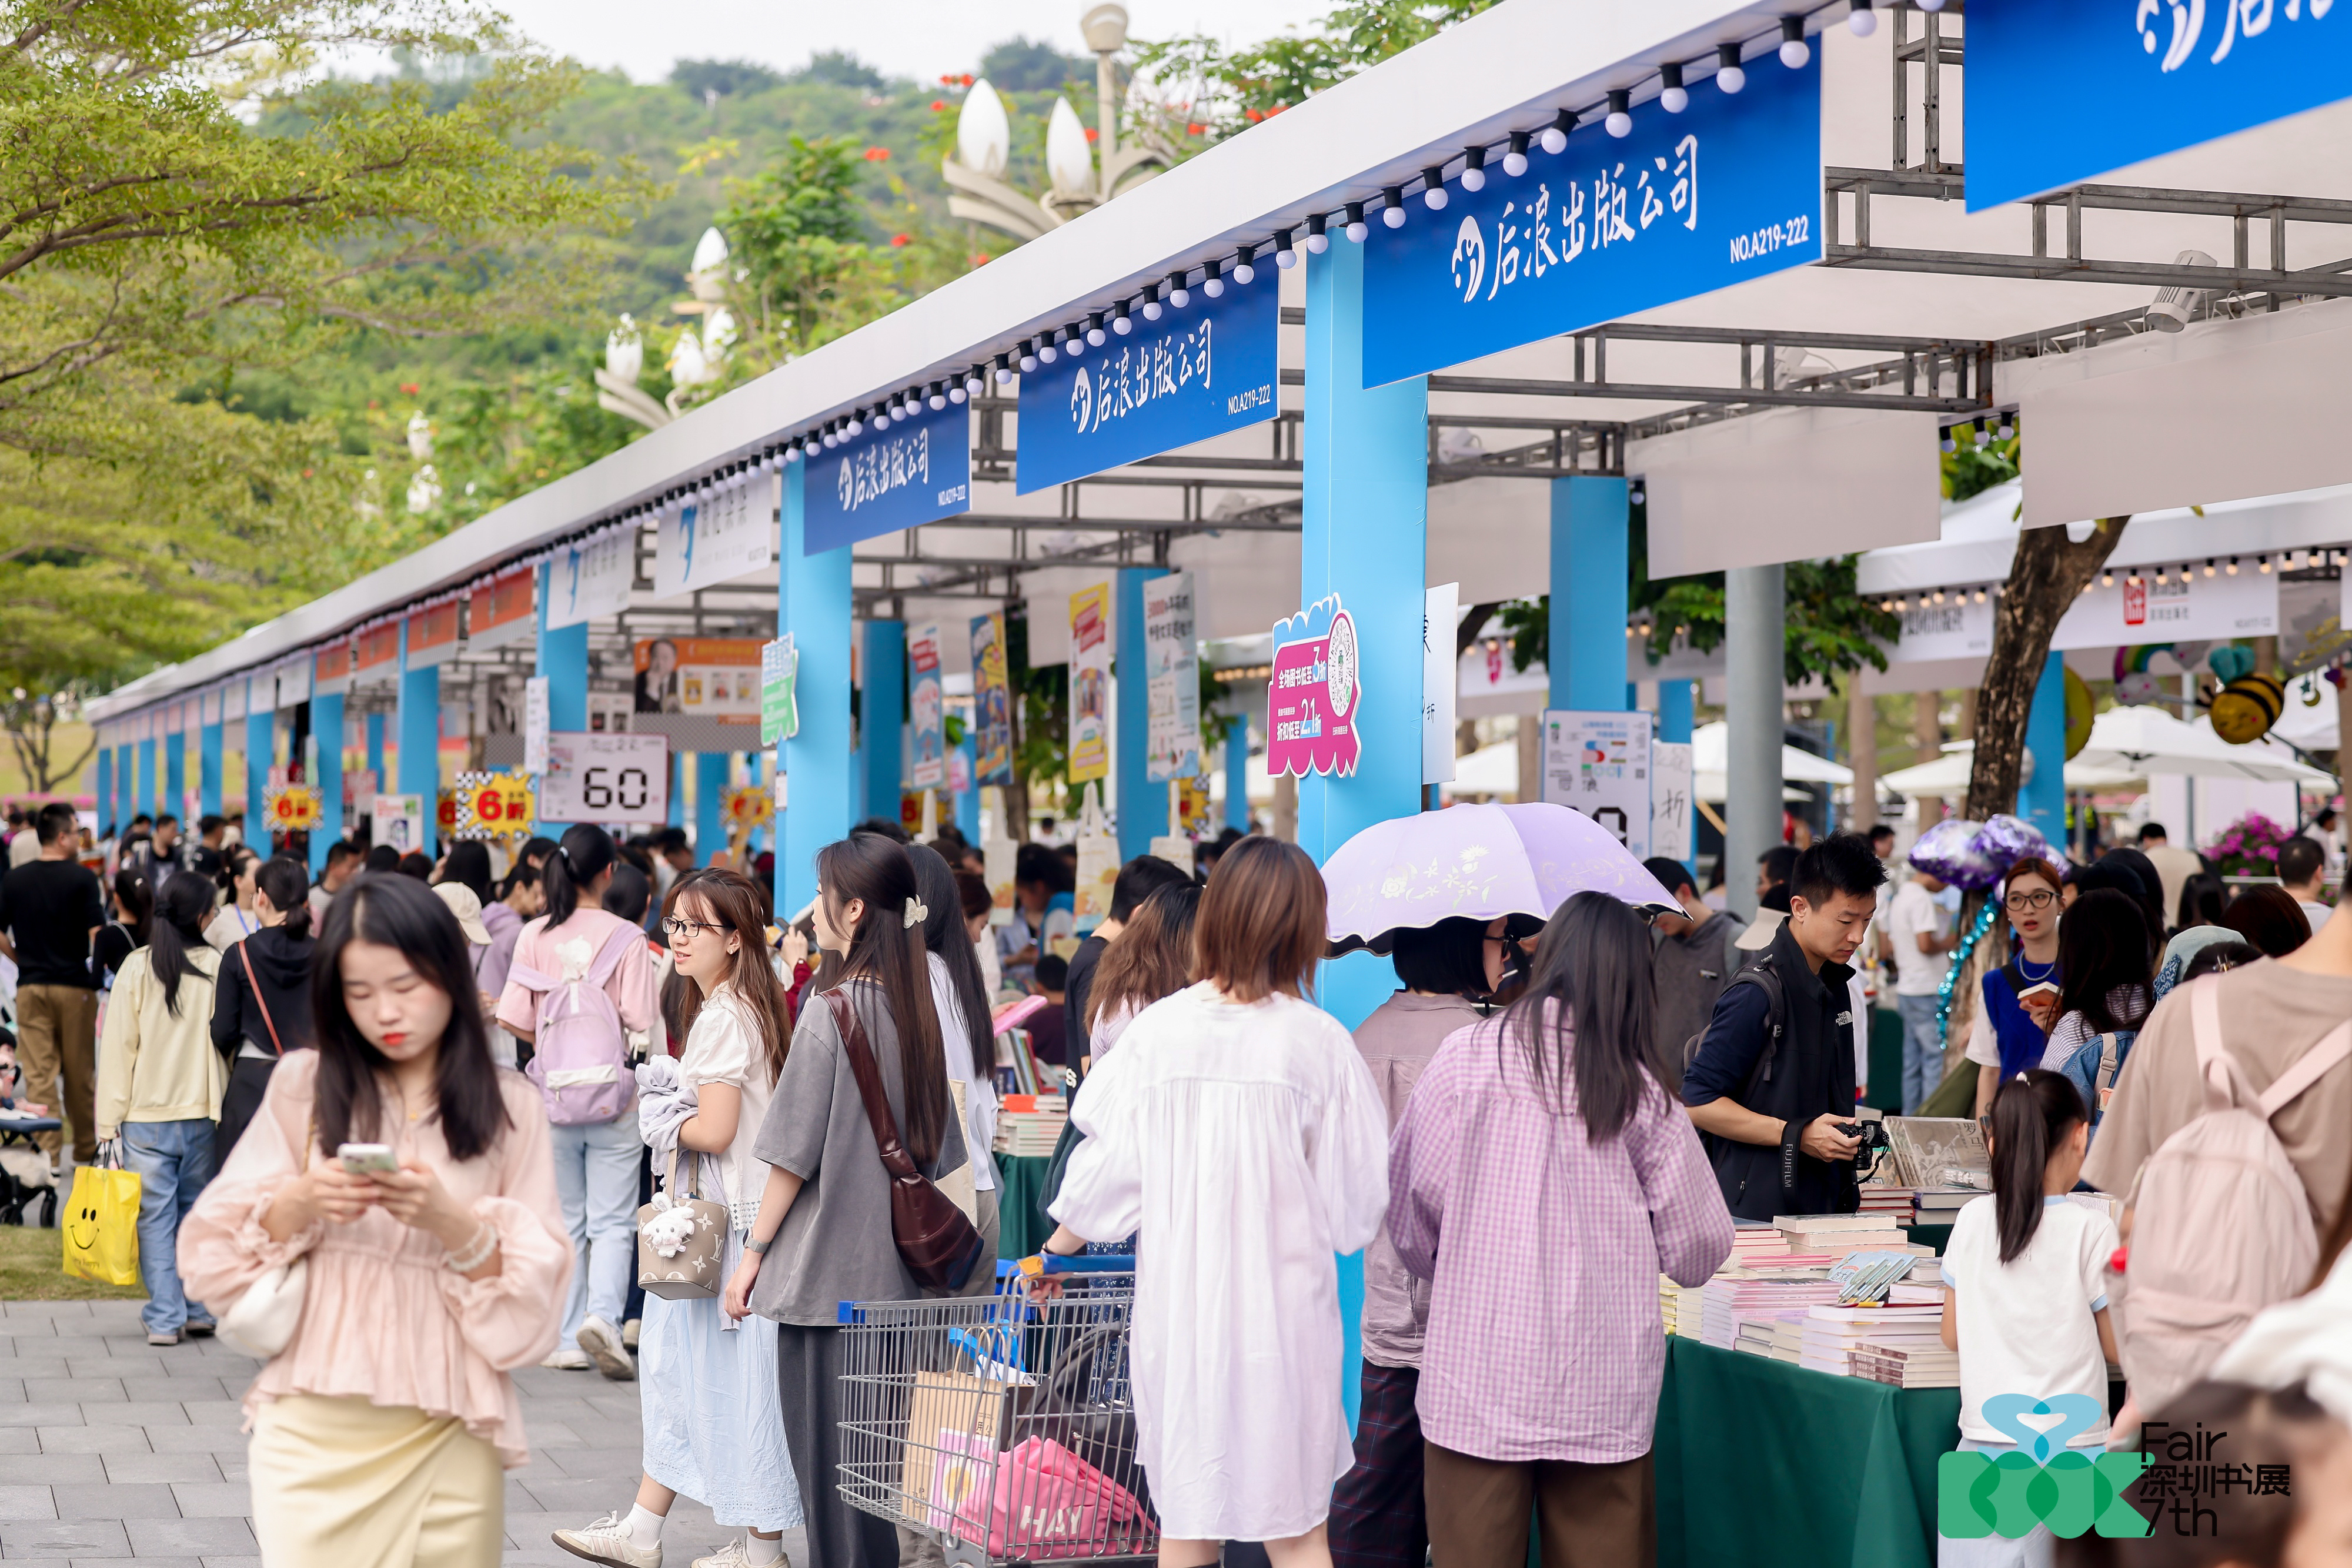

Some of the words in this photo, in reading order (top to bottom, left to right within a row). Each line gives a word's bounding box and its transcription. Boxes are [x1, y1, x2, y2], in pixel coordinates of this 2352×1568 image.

[1488, 134, 1698, 302] 后浪出版公司
[1729, 215, 1809, 264] NO.A219-222
[1092, 318, 1212, 433] 后浪出版公司
[1228, 384, 1271, 416] NO.A219-222
[852, 427, 928, 511] 后浪出版公司
[938, 484, 966, 507] NO.A219-222
[1278, 646, 1327, 689] 全场图书低至3折
[584, 767, 647, 810] 60
[1784, 1144, 1793, 1187] FUJIFILM
[1019, 1505, 1082, 1537] HAY
